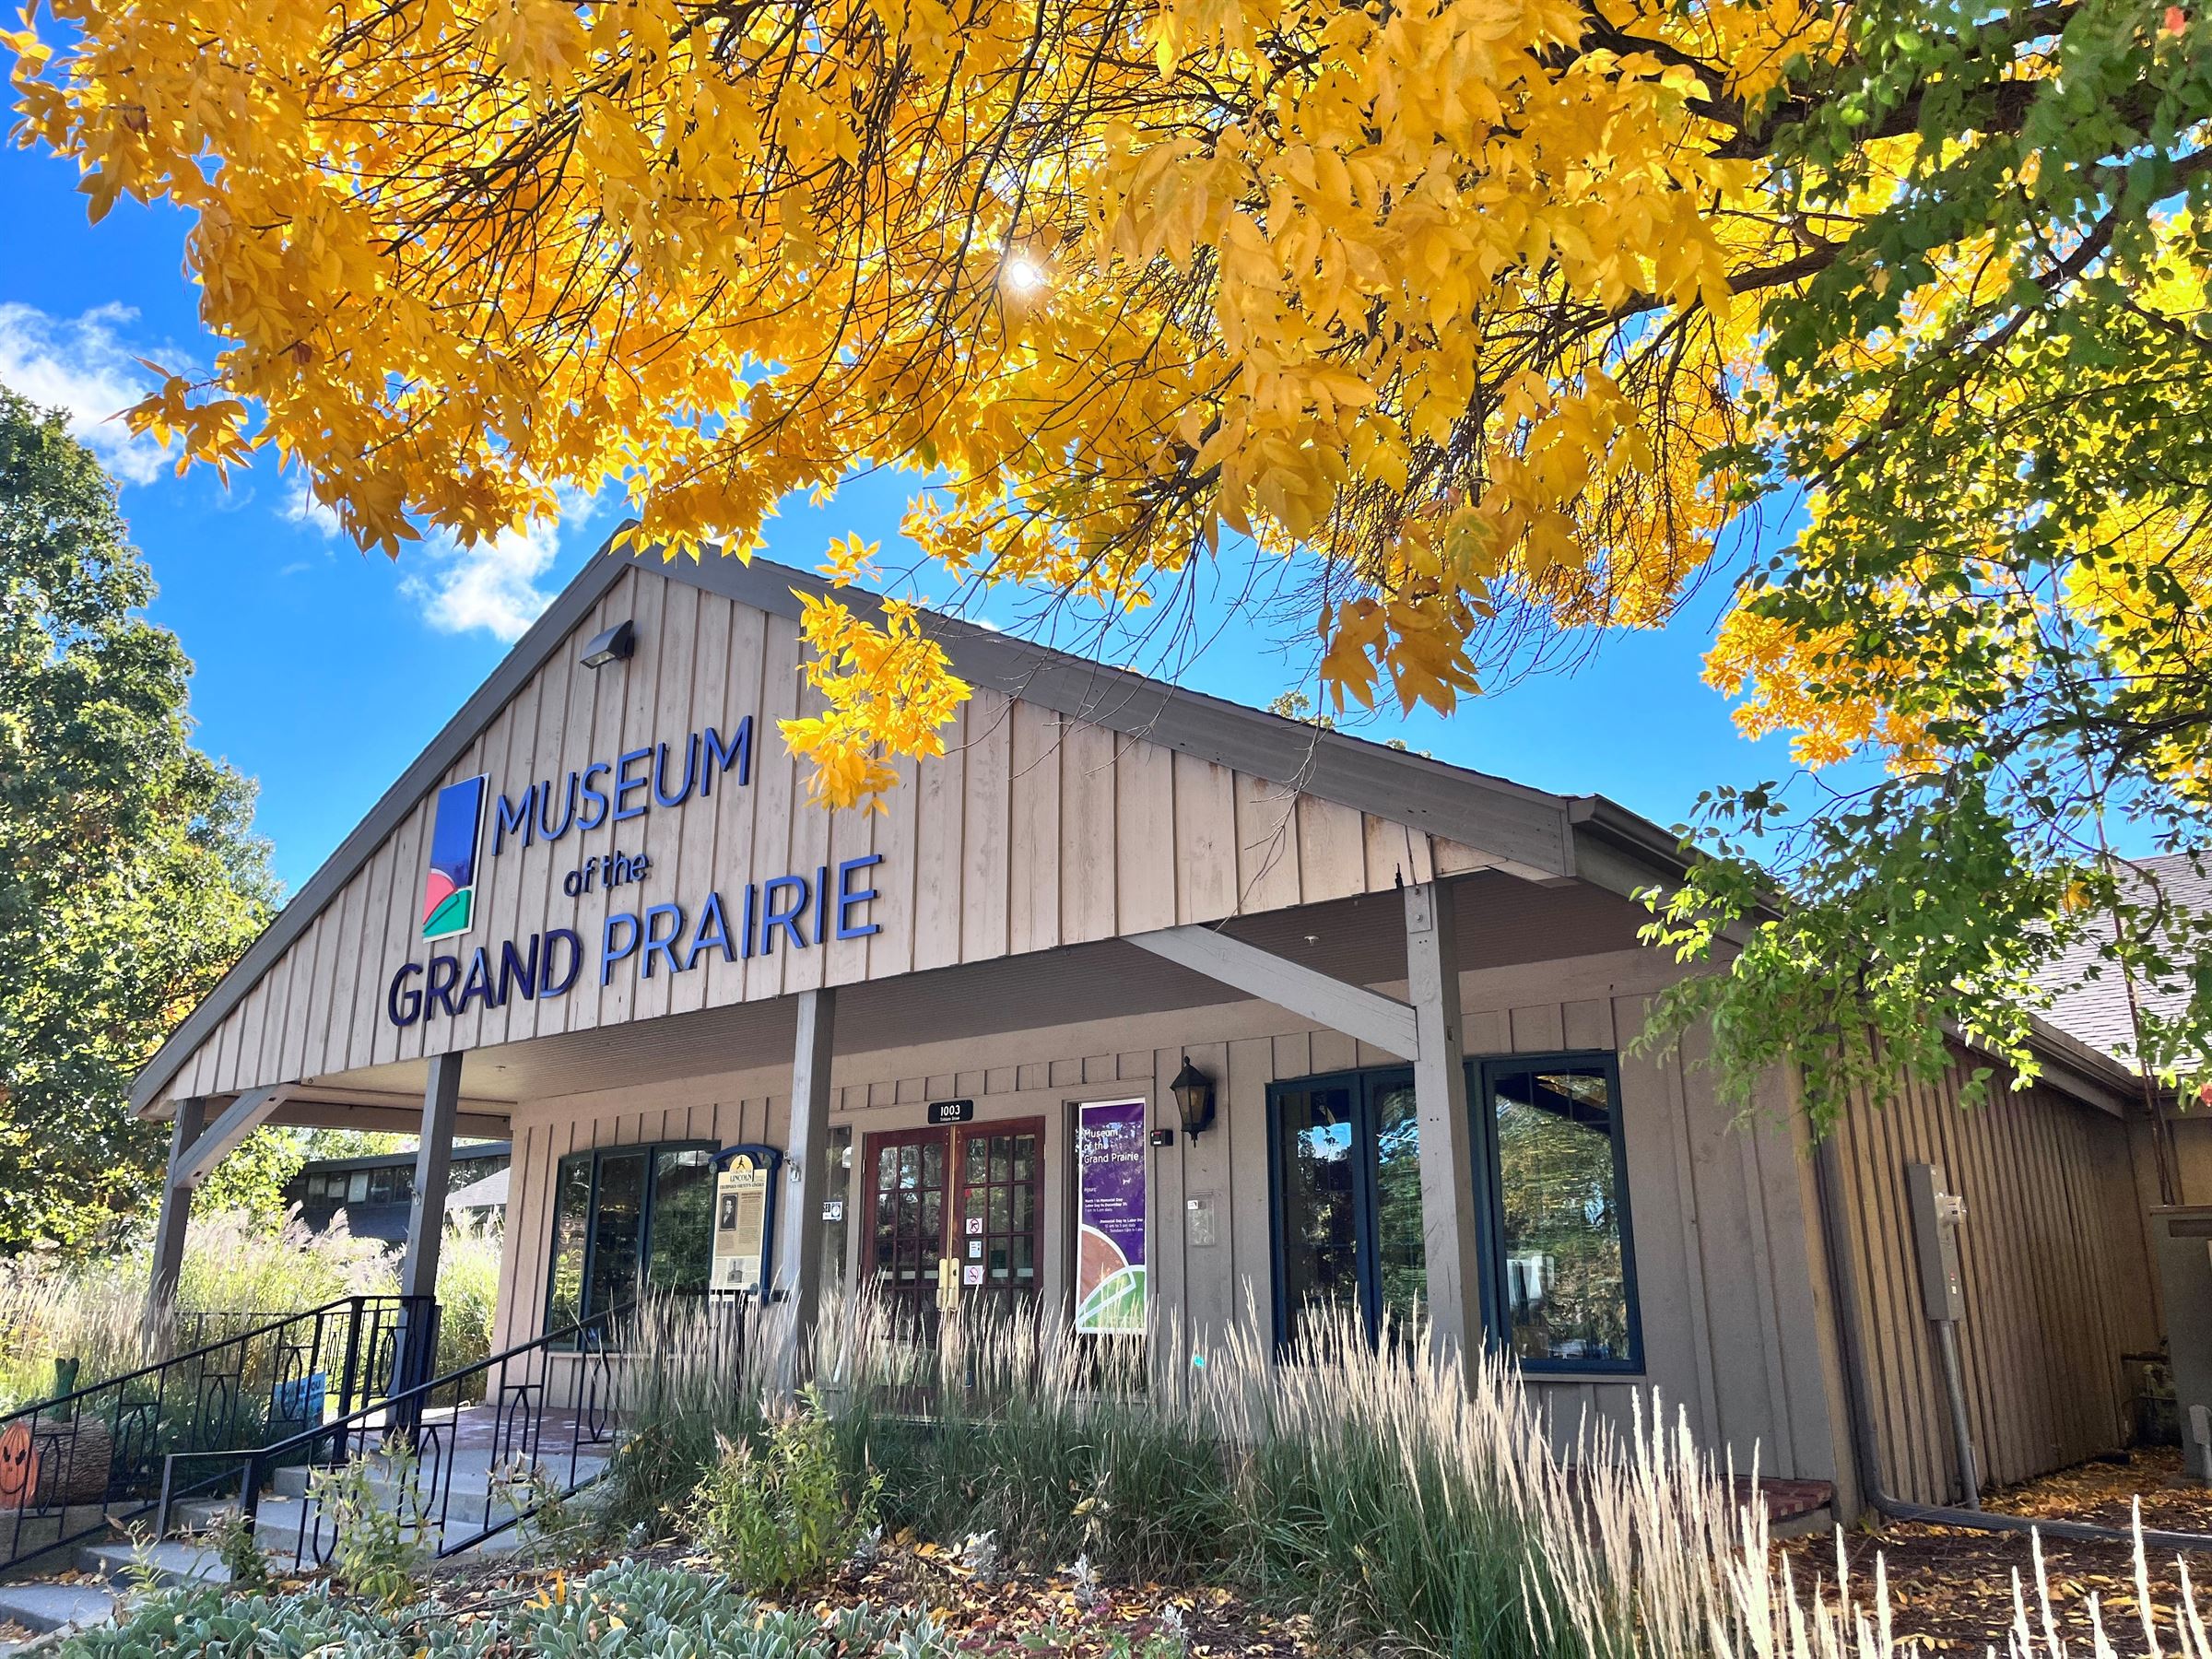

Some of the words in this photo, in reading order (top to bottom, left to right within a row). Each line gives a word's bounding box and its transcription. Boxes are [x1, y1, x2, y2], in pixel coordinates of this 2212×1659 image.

[491, 715, 753, 856] MUSEUM
[563, 856, 597, 897] of
[601, 850, 650, 888] the
[388, 928, 583, 1027] GRAND
[601, 853, 883, 987] PRAIRIE
[940, 1104, 960, 1116] 1003
[1084, 1129, 1118, 1138] Museum
[1084, 1142, 1092, 1151] of
[1084, 1154, 1109, 1164] Grand
[1112, 1152, 1139, 1162] Prairie
[730, 1173, 752, 1182] LINCOLN
